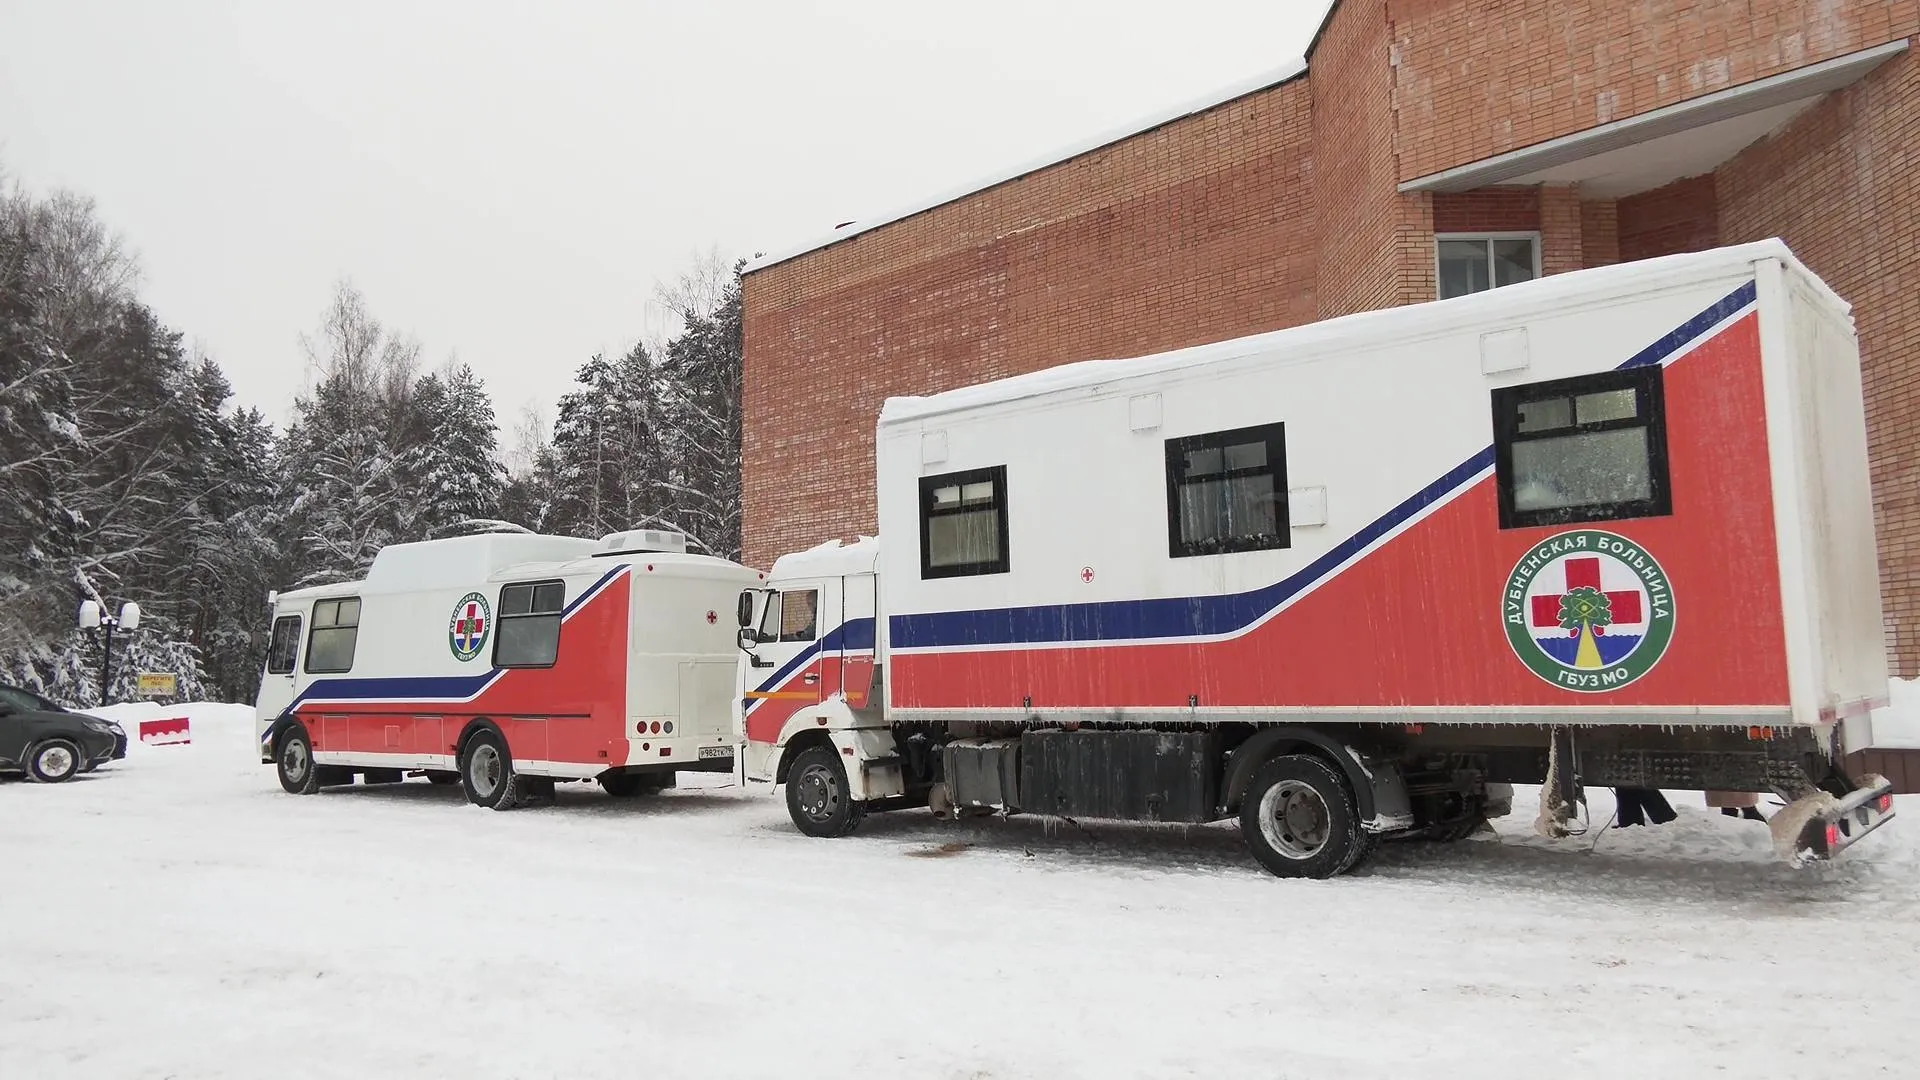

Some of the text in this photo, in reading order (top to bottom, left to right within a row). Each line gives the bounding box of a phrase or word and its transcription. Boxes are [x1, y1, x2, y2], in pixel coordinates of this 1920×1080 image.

[1507, 535, 1669, 625] ДУБНЕНСКАЯ БОЛЬНИЦА
[1557, 667, 1629, 687] ГБУЗ МО
